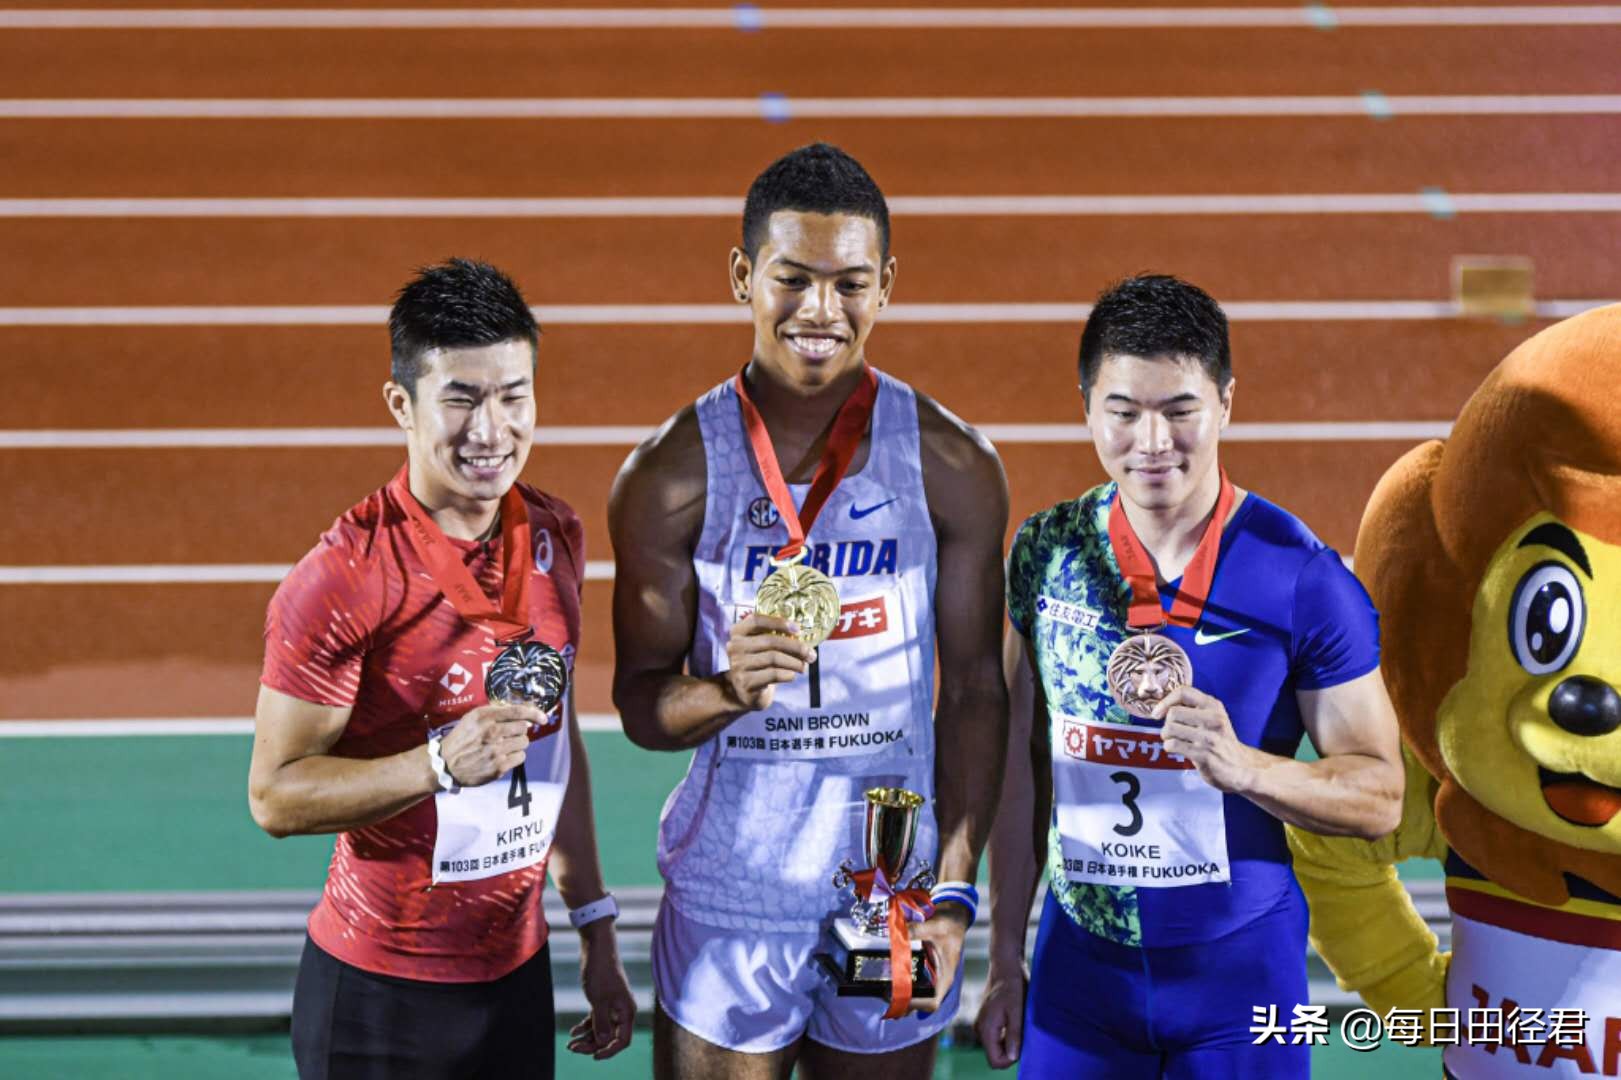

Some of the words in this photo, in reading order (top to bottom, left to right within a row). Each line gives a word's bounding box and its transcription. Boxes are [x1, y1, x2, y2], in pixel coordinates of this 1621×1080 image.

[751, 498, 779, 521] SEC
[744, 539, 898, 581] FRIDA
[808, 646, 821, 708] 1
[765, 716, 803, 731] SANI
[808, 713, 869, 730] BROWN
[727, 736, 765, 750] 第103回
[770, 738, 824, 751] 日本選手権
[829, 729, 904, 748] FUKUOKA
[507, 763, 533, 817] 4
[1109, 771, 1144, 837] 3
[496, 820, 544, 846] KIRYU
[1101, 842, 1161, 860] KOIKE
[1087, 860, 1138, 878] 日本選手権
[1142, 862, 1220, 878] FUKUOKA
